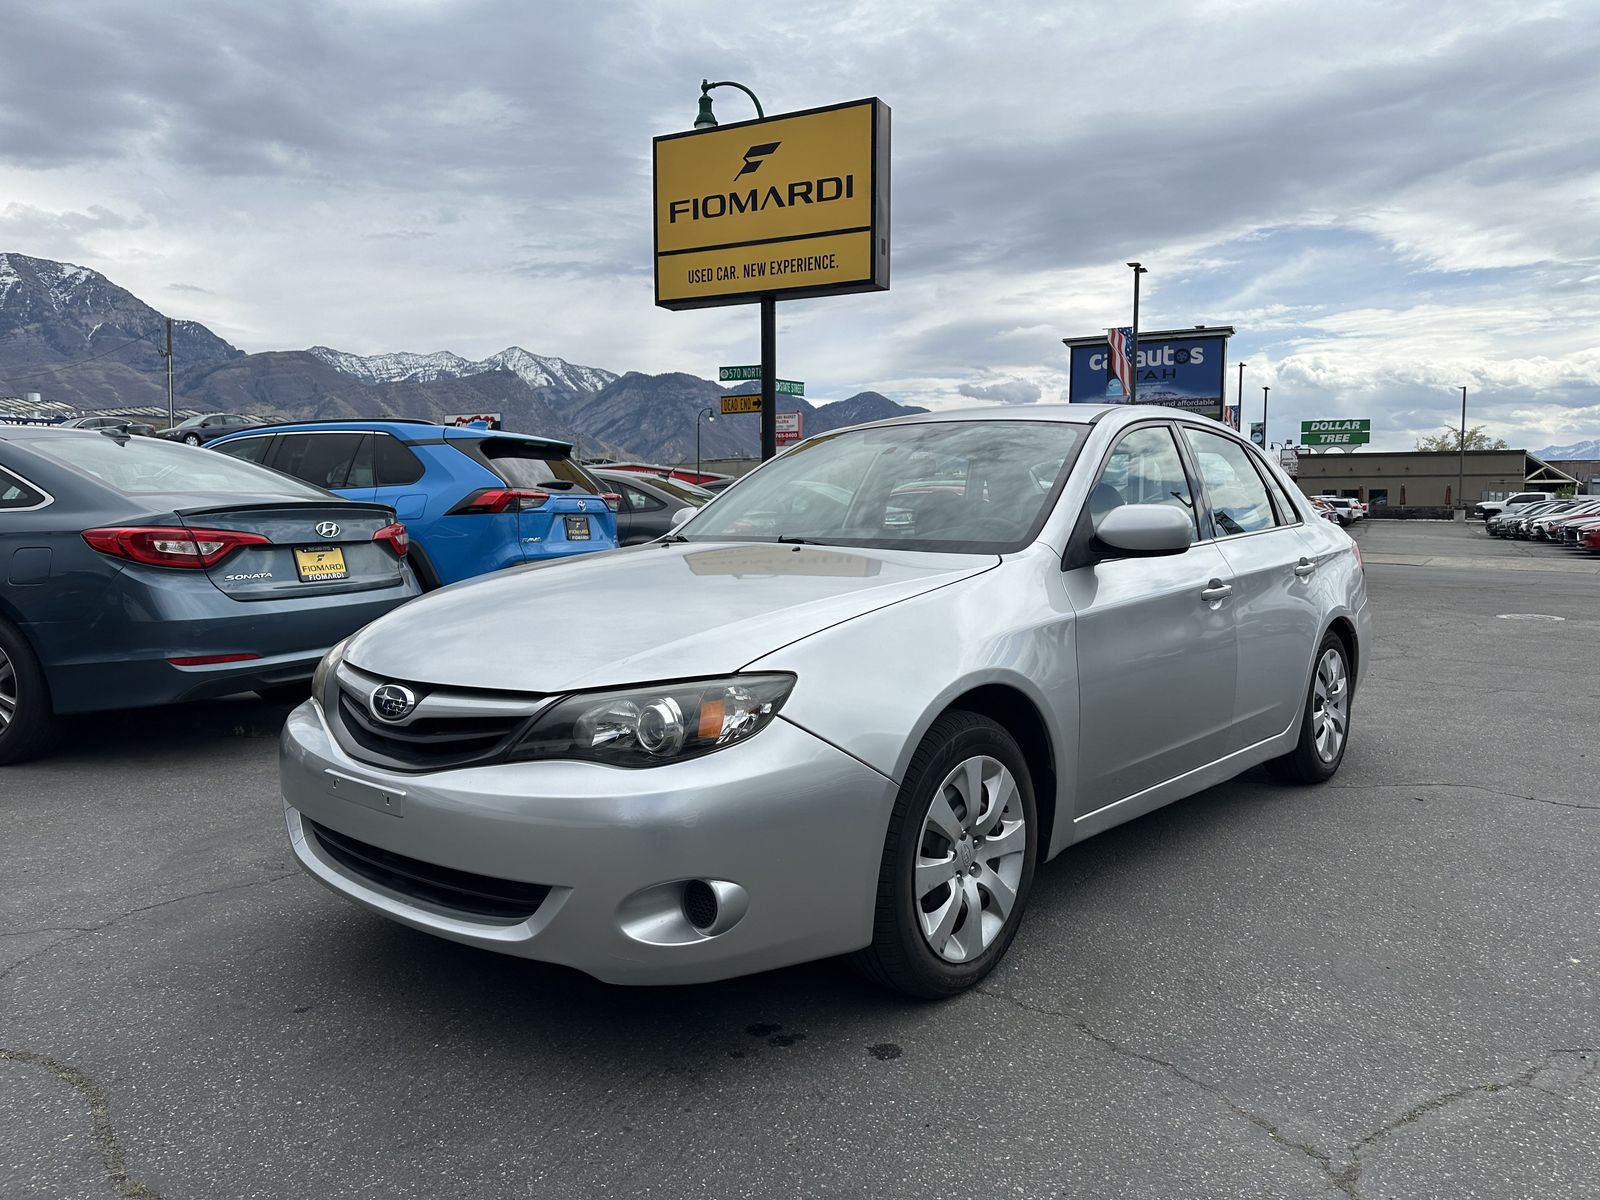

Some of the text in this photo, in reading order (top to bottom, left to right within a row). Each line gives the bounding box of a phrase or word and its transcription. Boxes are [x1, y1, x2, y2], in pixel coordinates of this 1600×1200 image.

[669, 174, 854, 224] FIOMARDI
[688, 254, 840, 284] USED CAR. NEW EXPERIENCE.
[729, 369, 741, 379] 570
[1136, 368, 1176, 380] TAH
[723, 397, 752, 411] DEAD END
[1177, 399, 1215, 407] affordable
[1310, 421, 1361, 431] DOLLAR
[1320, 434, 1351, 443] TREE
[302, 563, 344, 572] FIOMARDI
[224, 572, 273, 582] SONATA
[308, 572, 344, 581] FIOMARDI
